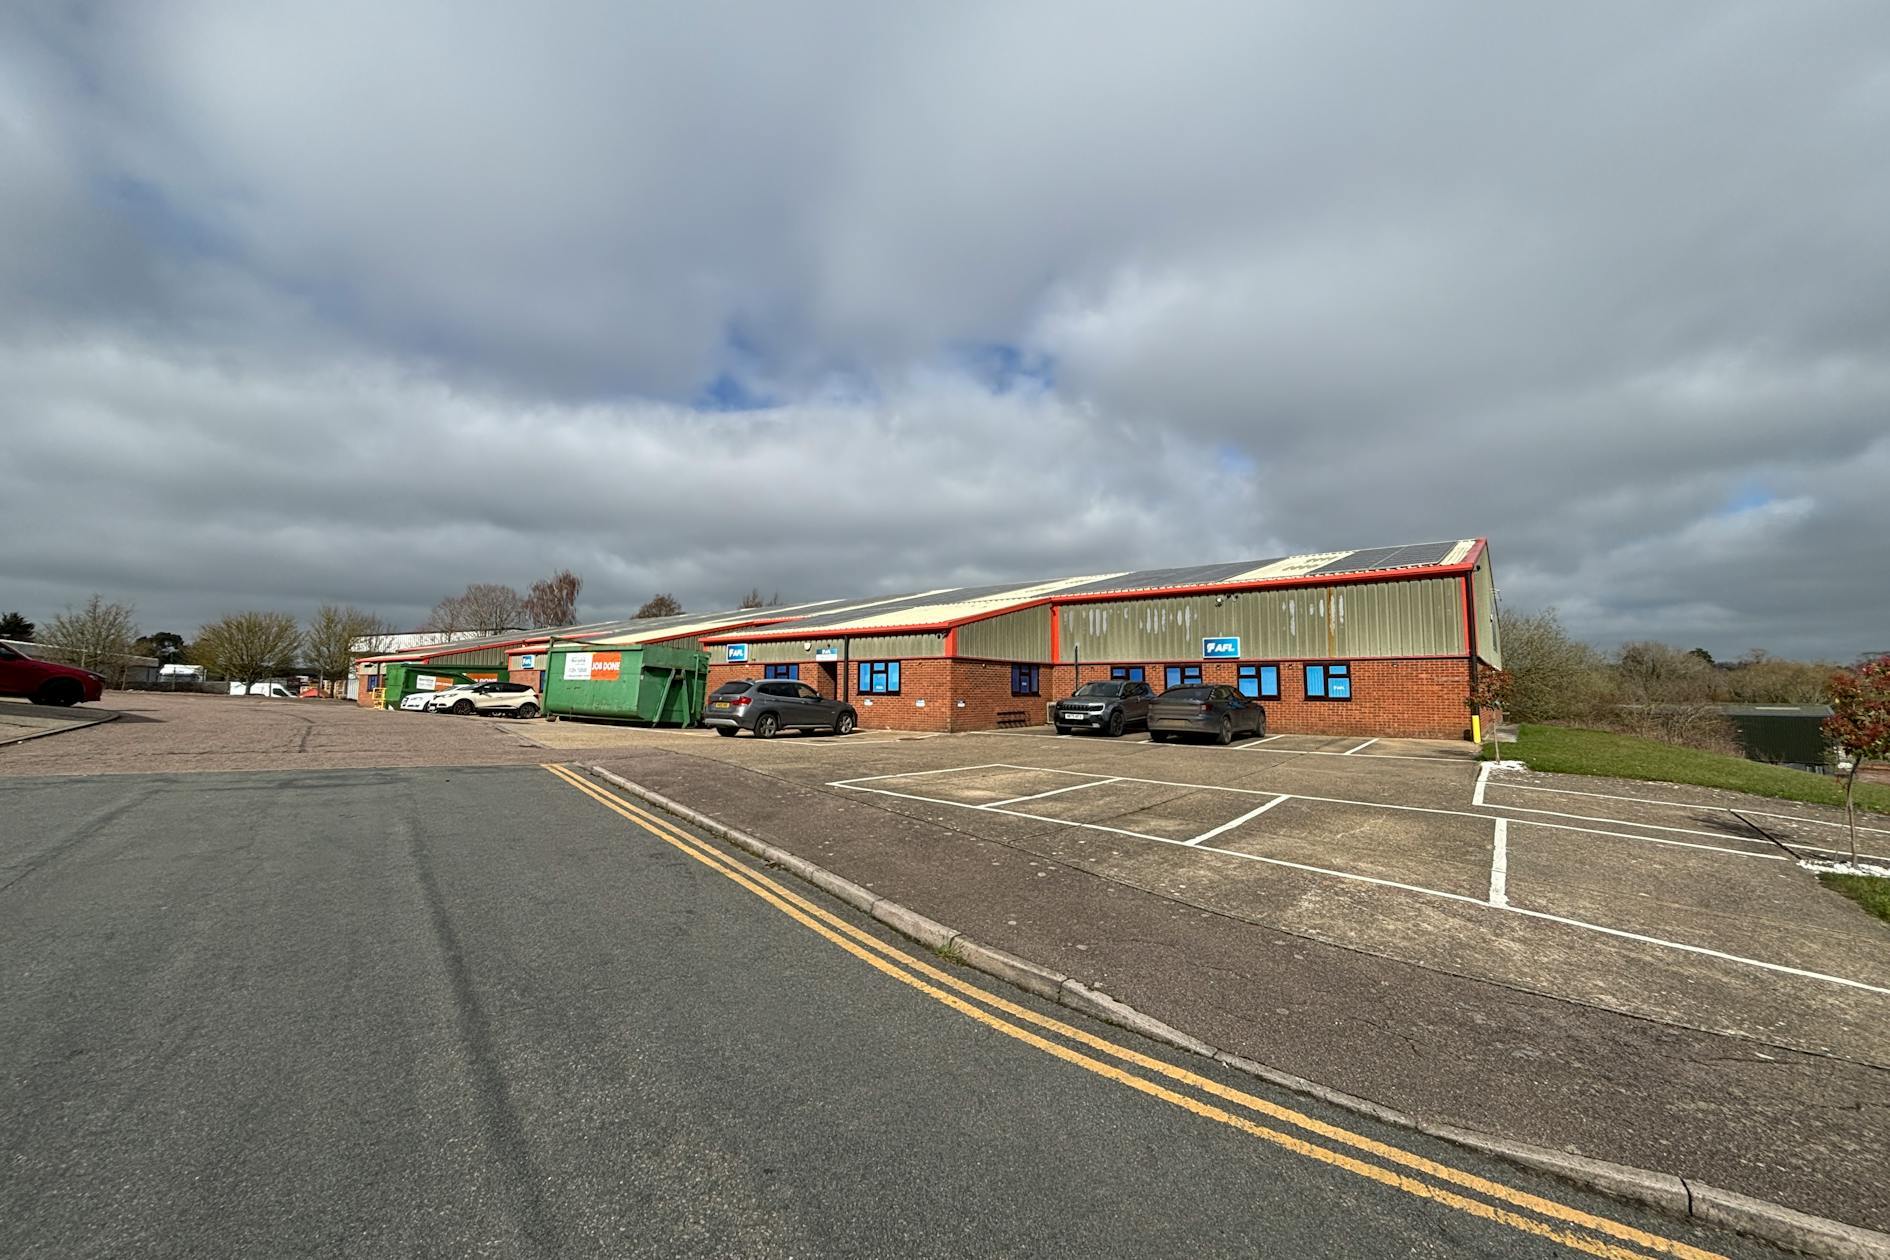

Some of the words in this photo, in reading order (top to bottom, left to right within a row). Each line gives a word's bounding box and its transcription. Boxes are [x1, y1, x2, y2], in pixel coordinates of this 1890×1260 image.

[1214, 643, 1235, 652] AFL
[592, 661, 602, 670] JOB
[603, 661, 620, 671] DONE
